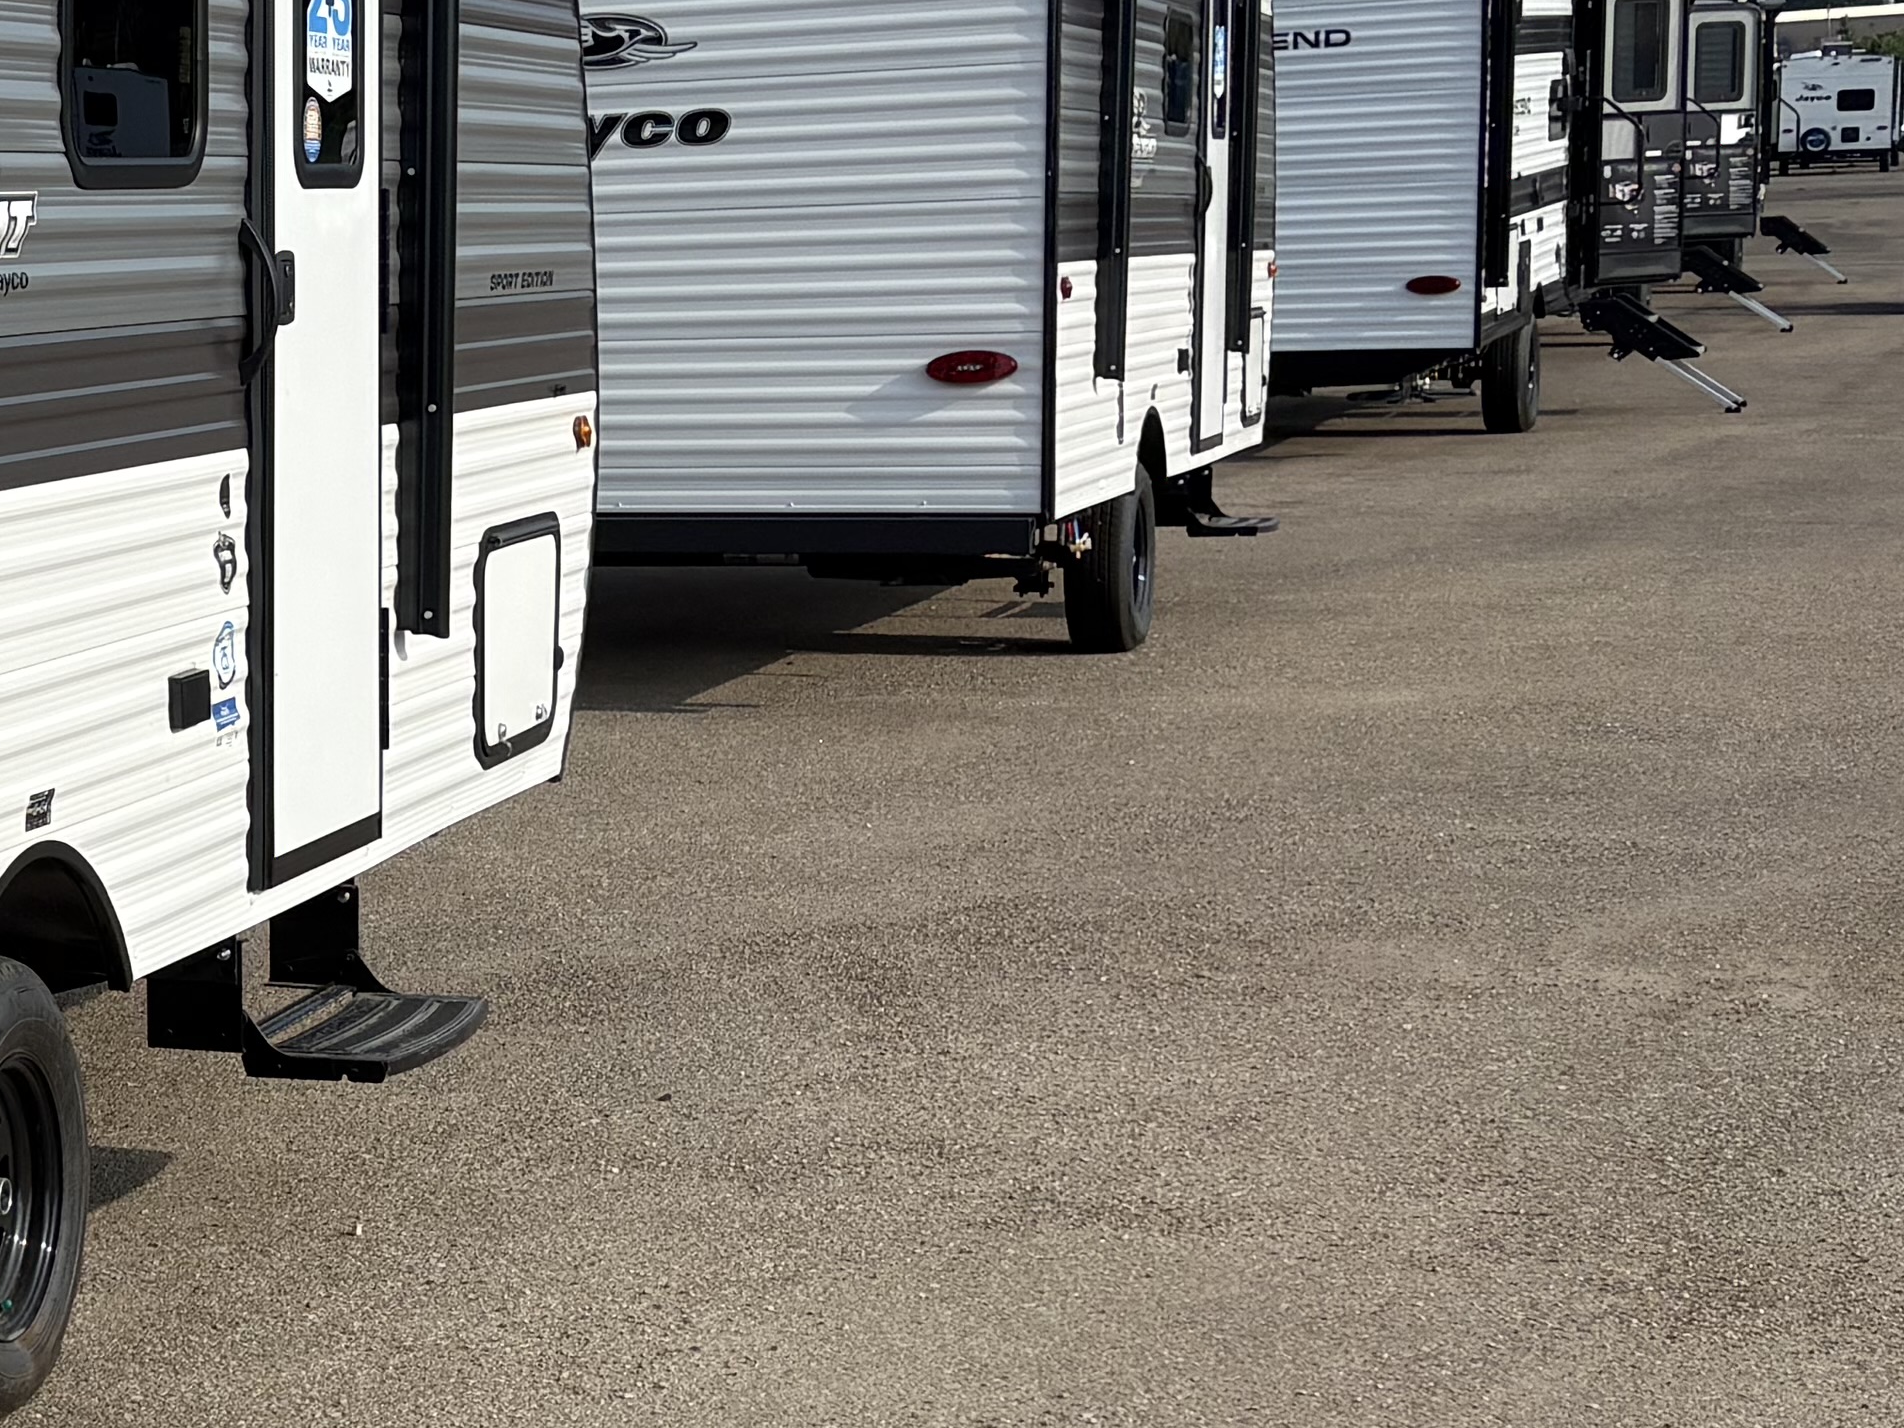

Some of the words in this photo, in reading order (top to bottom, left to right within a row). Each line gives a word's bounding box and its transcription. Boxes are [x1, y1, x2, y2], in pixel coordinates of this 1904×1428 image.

[1273, 29, 1352, 50] END
[309, 57, 350, 78] WARRANTY
[589, 108, 732, 162] yco
[490, 272, 519, 291] SPORT
[521, 270, 554, 289] EDITION
